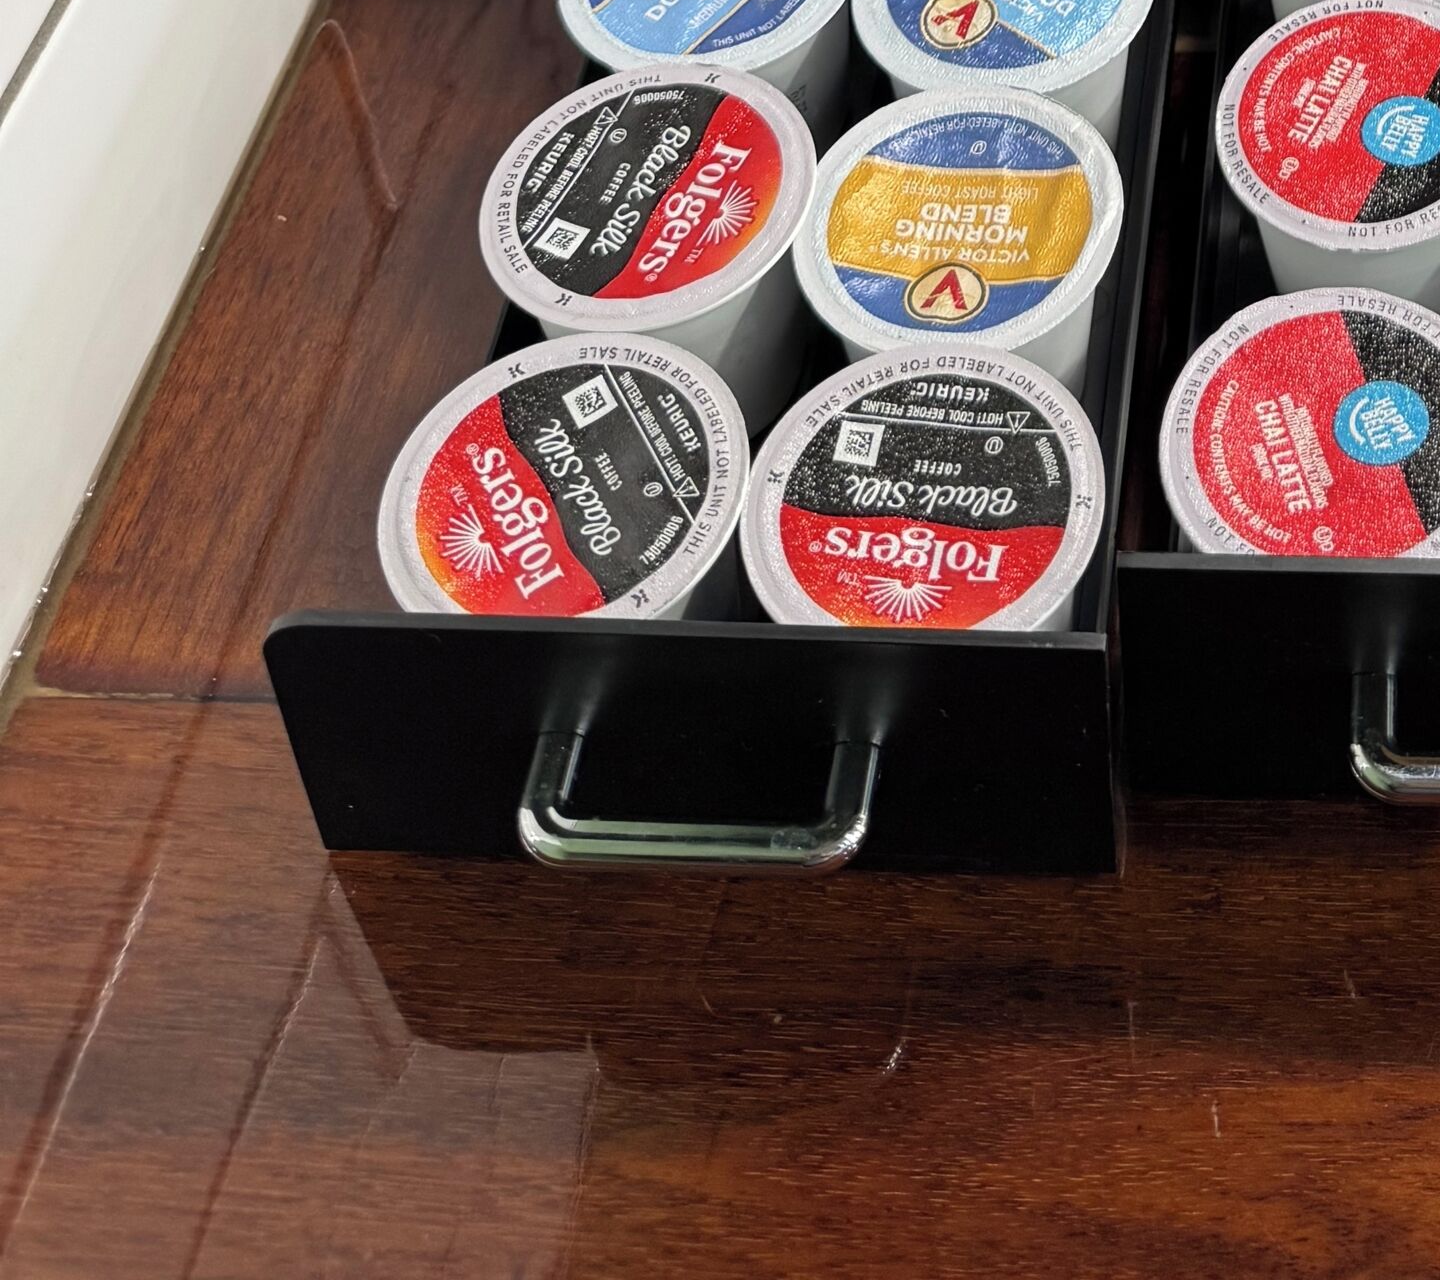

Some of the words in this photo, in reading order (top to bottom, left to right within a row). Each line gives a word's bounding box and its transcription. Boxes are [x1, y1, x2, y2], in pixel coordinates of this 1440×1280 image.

[713, 36, 734, 47] THIS
[735, 29, 756, 42] UNIT
[758, 19, 777, 33] NOT
[1317, 54, 1353, 93] CHAI
[633, 89, 686, 105] 75050006
[1287, 93, 1331, 143] LATTE
[1381, 113, 1411, 152] BELLY
[1402, 113, 1430, 158] HAPPY
[526, 130, 575, 193] KEURIG
[630, 125, 692, 205] Black
[598, 162, 632, 205] COFFEE
[901, 181, 952, 194] COFFEE
[954, 184, 999, 199] ROAST
[1002, 187, 1039, 200] LIGHT
[638, 139, 753, 274] Folgers
[920, 203, 1012, 224] BLEND
[588, 200, 642, 257] Silk
[895, 219, 1029, 245] MORNING
[1348, 225, 1378, 237] NOT
[1385, 219, 1416, 235] FOR
[957, 247, 1031, 265] VICTOR
[579, 346, 617, 360] SALE
[1213, 323, 1250, 350] NOT
[624, 347, 670, 373] RETAIL
[667, 361, 698, 390] FOR
[1193, 348, 1222, 377] FOR
[618, 370, 643, 407] PEELING
[908, 380, 991, 401] KEURIG
[1175, 378, 1203, 435] RESALE
[635, 401, 662, 437] BEFORE
[661, 393, 702, 453] KEURIG
[693, 384, 730, 443] LABELED
[861, 400, 904, 416] PEELING
[905, 406, 945, 421] BEFORE
[948, 408, 975, 423] COOL
[975, 412, 1005, 425] HOT!
[1373, 396, 1419, 446] HAPPY
[535, 418, 585, 478] Silk
[652, 433, 672, 462] COOL
[1359, 410, 1394, 451] BELLY
[594, 451, 624, 491] COFFEE
[666, 457, 685, 483] HOT!
[716, 443, 733, 478] NOT
[913, 459, 962, 475] COFFEE
[1034, 435, 1062, 487] 75050006
[1254, 400, 1283, 451] CHAI
[1271, 445, 1311, 513] LATTE
[707, 481, 730, 518] UNIT
[846, 473, 908, 514] Silk
[918, 486, 1019, 517] Black
[472, 446, 564, 600] Folgers
[562, 474, 622, 557] Black
[639, 514, 684, 565] 75050006
[682, 520, 713, 558] THIS
[824, 526, 1011, 582] Folgers
